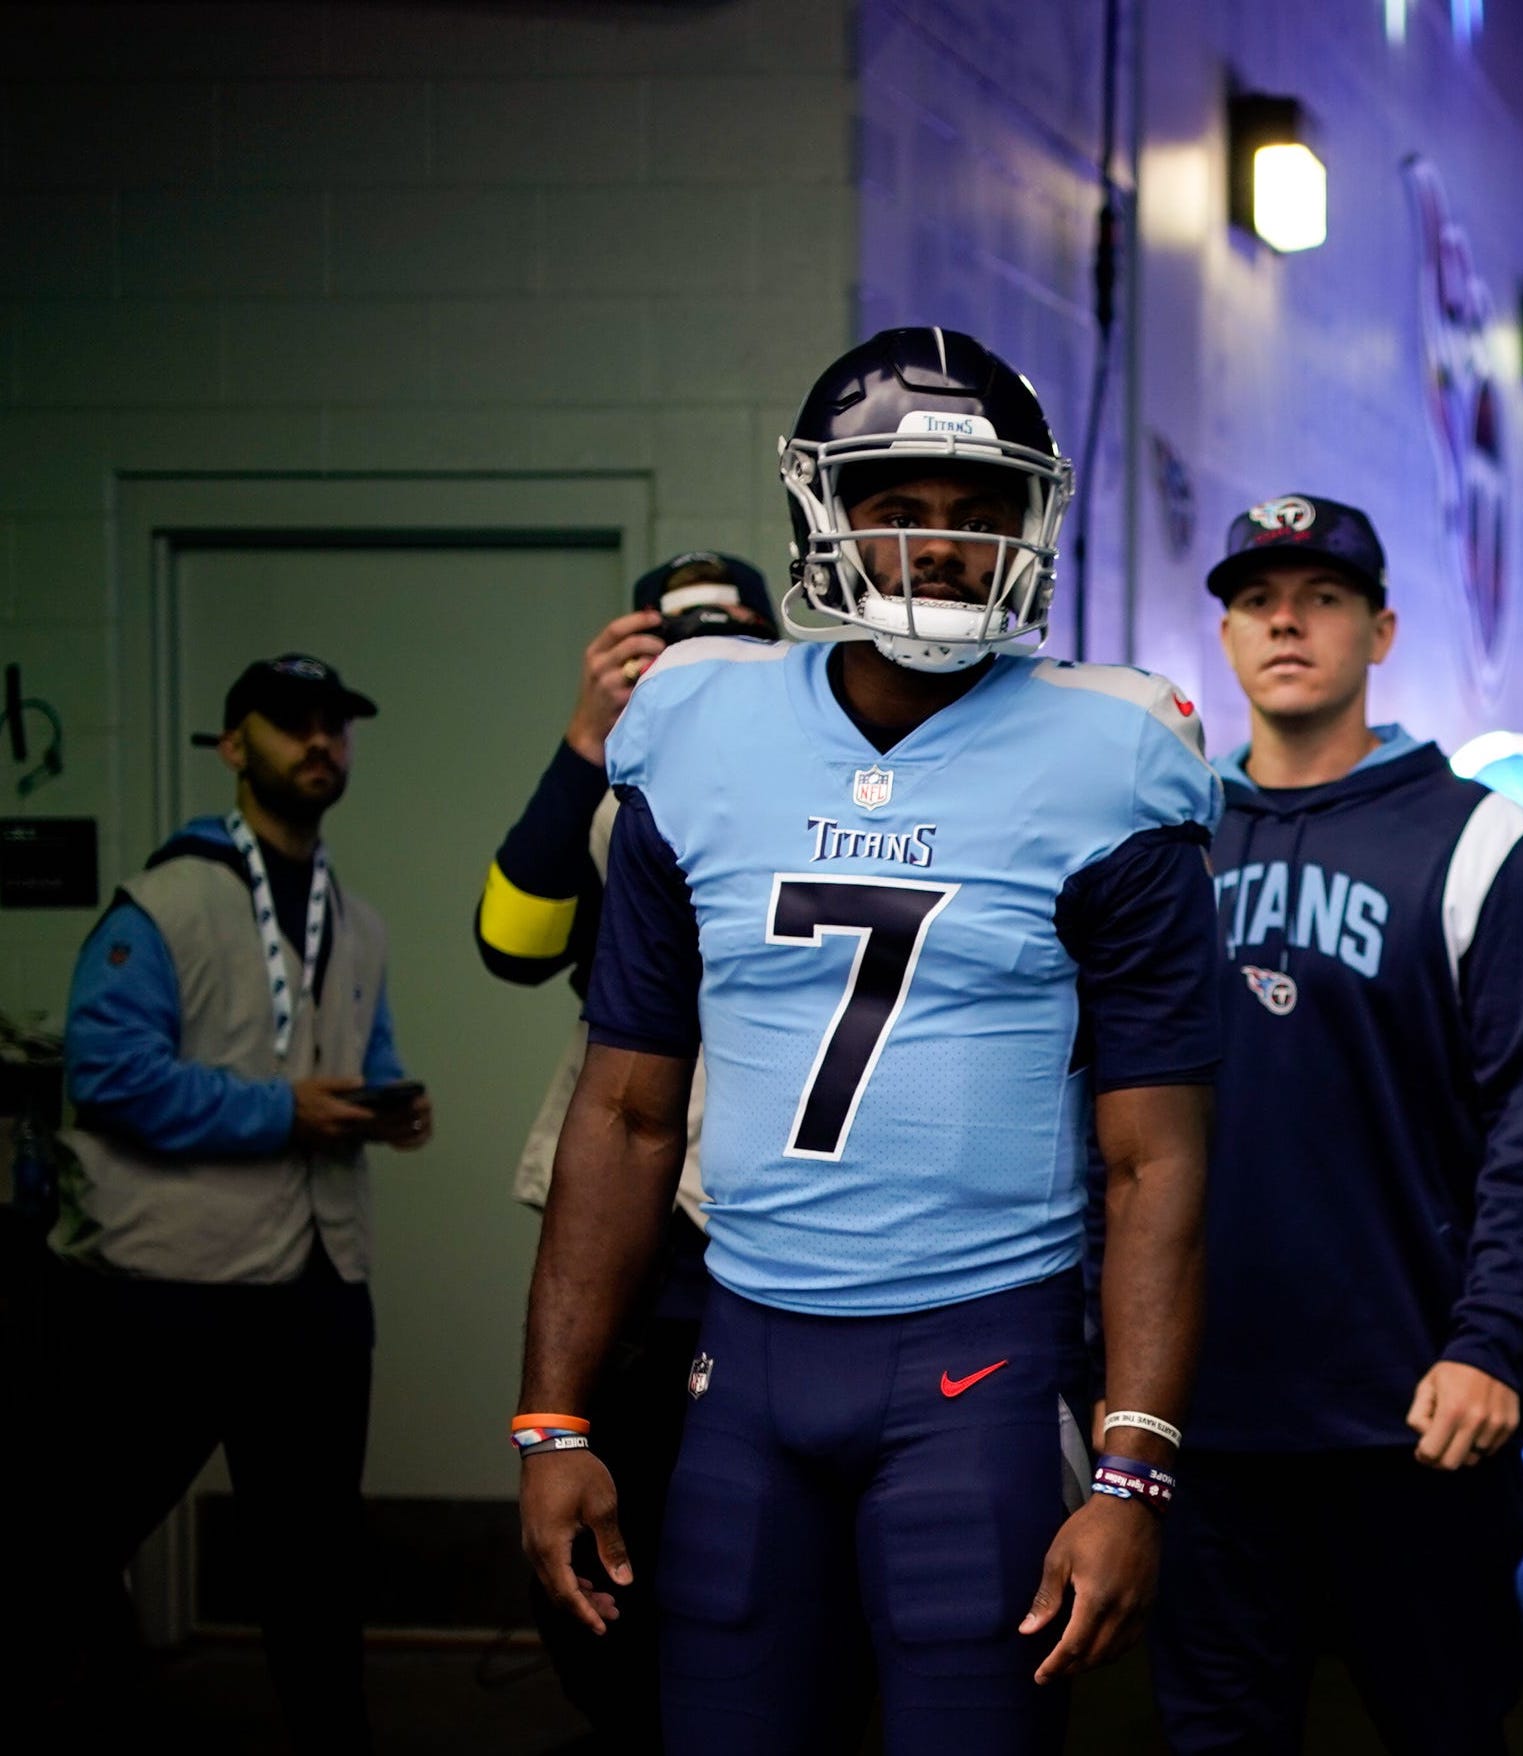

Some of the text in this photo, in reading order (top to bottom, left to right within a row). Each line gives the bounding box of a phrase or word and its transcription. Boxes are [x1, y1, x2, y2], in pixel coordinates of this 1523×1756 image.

[923, 415, 974, 435] TITANS
[860, 784, 885, 802] NFL
[807, 815, 937, 868] TITANS
[1214, 861, 1389, 978] TANS
[765, 872, 962, 1162] 7
[1138, 1416, 1157, 1428] HAVE
